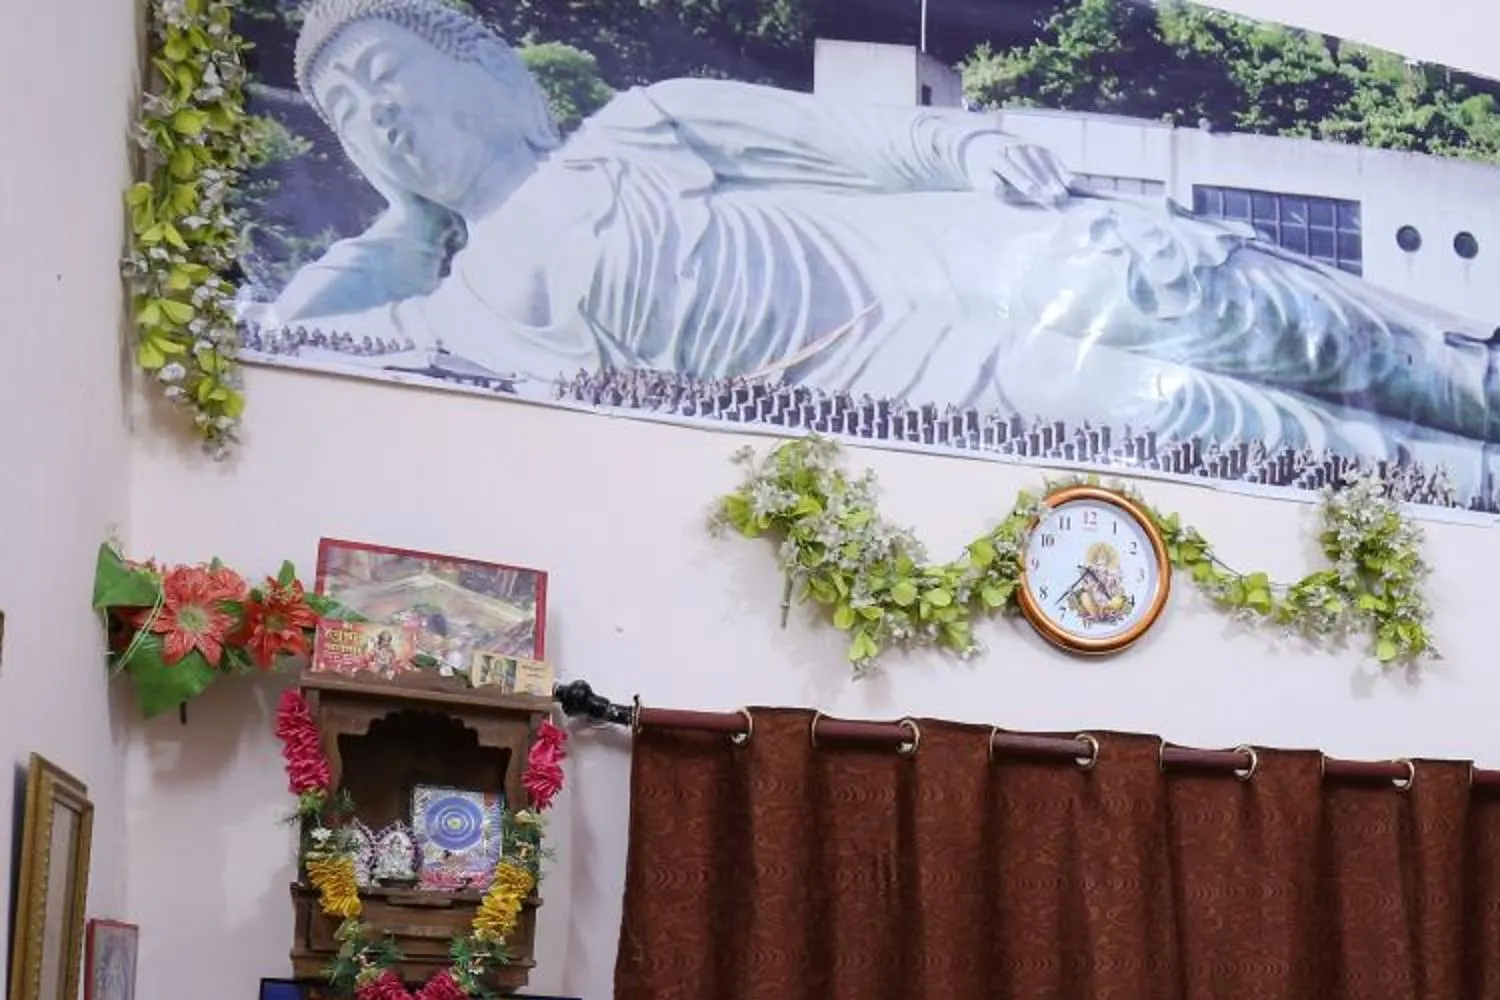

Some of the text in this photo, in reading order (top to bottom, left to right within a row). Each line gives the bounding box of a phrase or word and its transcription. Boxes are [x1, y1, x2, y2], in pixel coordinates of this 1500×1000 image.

[1059, 516, 1071, 531] 11
[1083, 510, 1098, 525] 12
[1112, 520, 1118, 535] 1
[1041, 533, 1055, 547] 10
[1128, 541, 1137, 555] 2
[1031, 557, 1039, 570] 9
[1039, 586, 1048, 600] 8
[1058, 606, 1067, 619] 7
